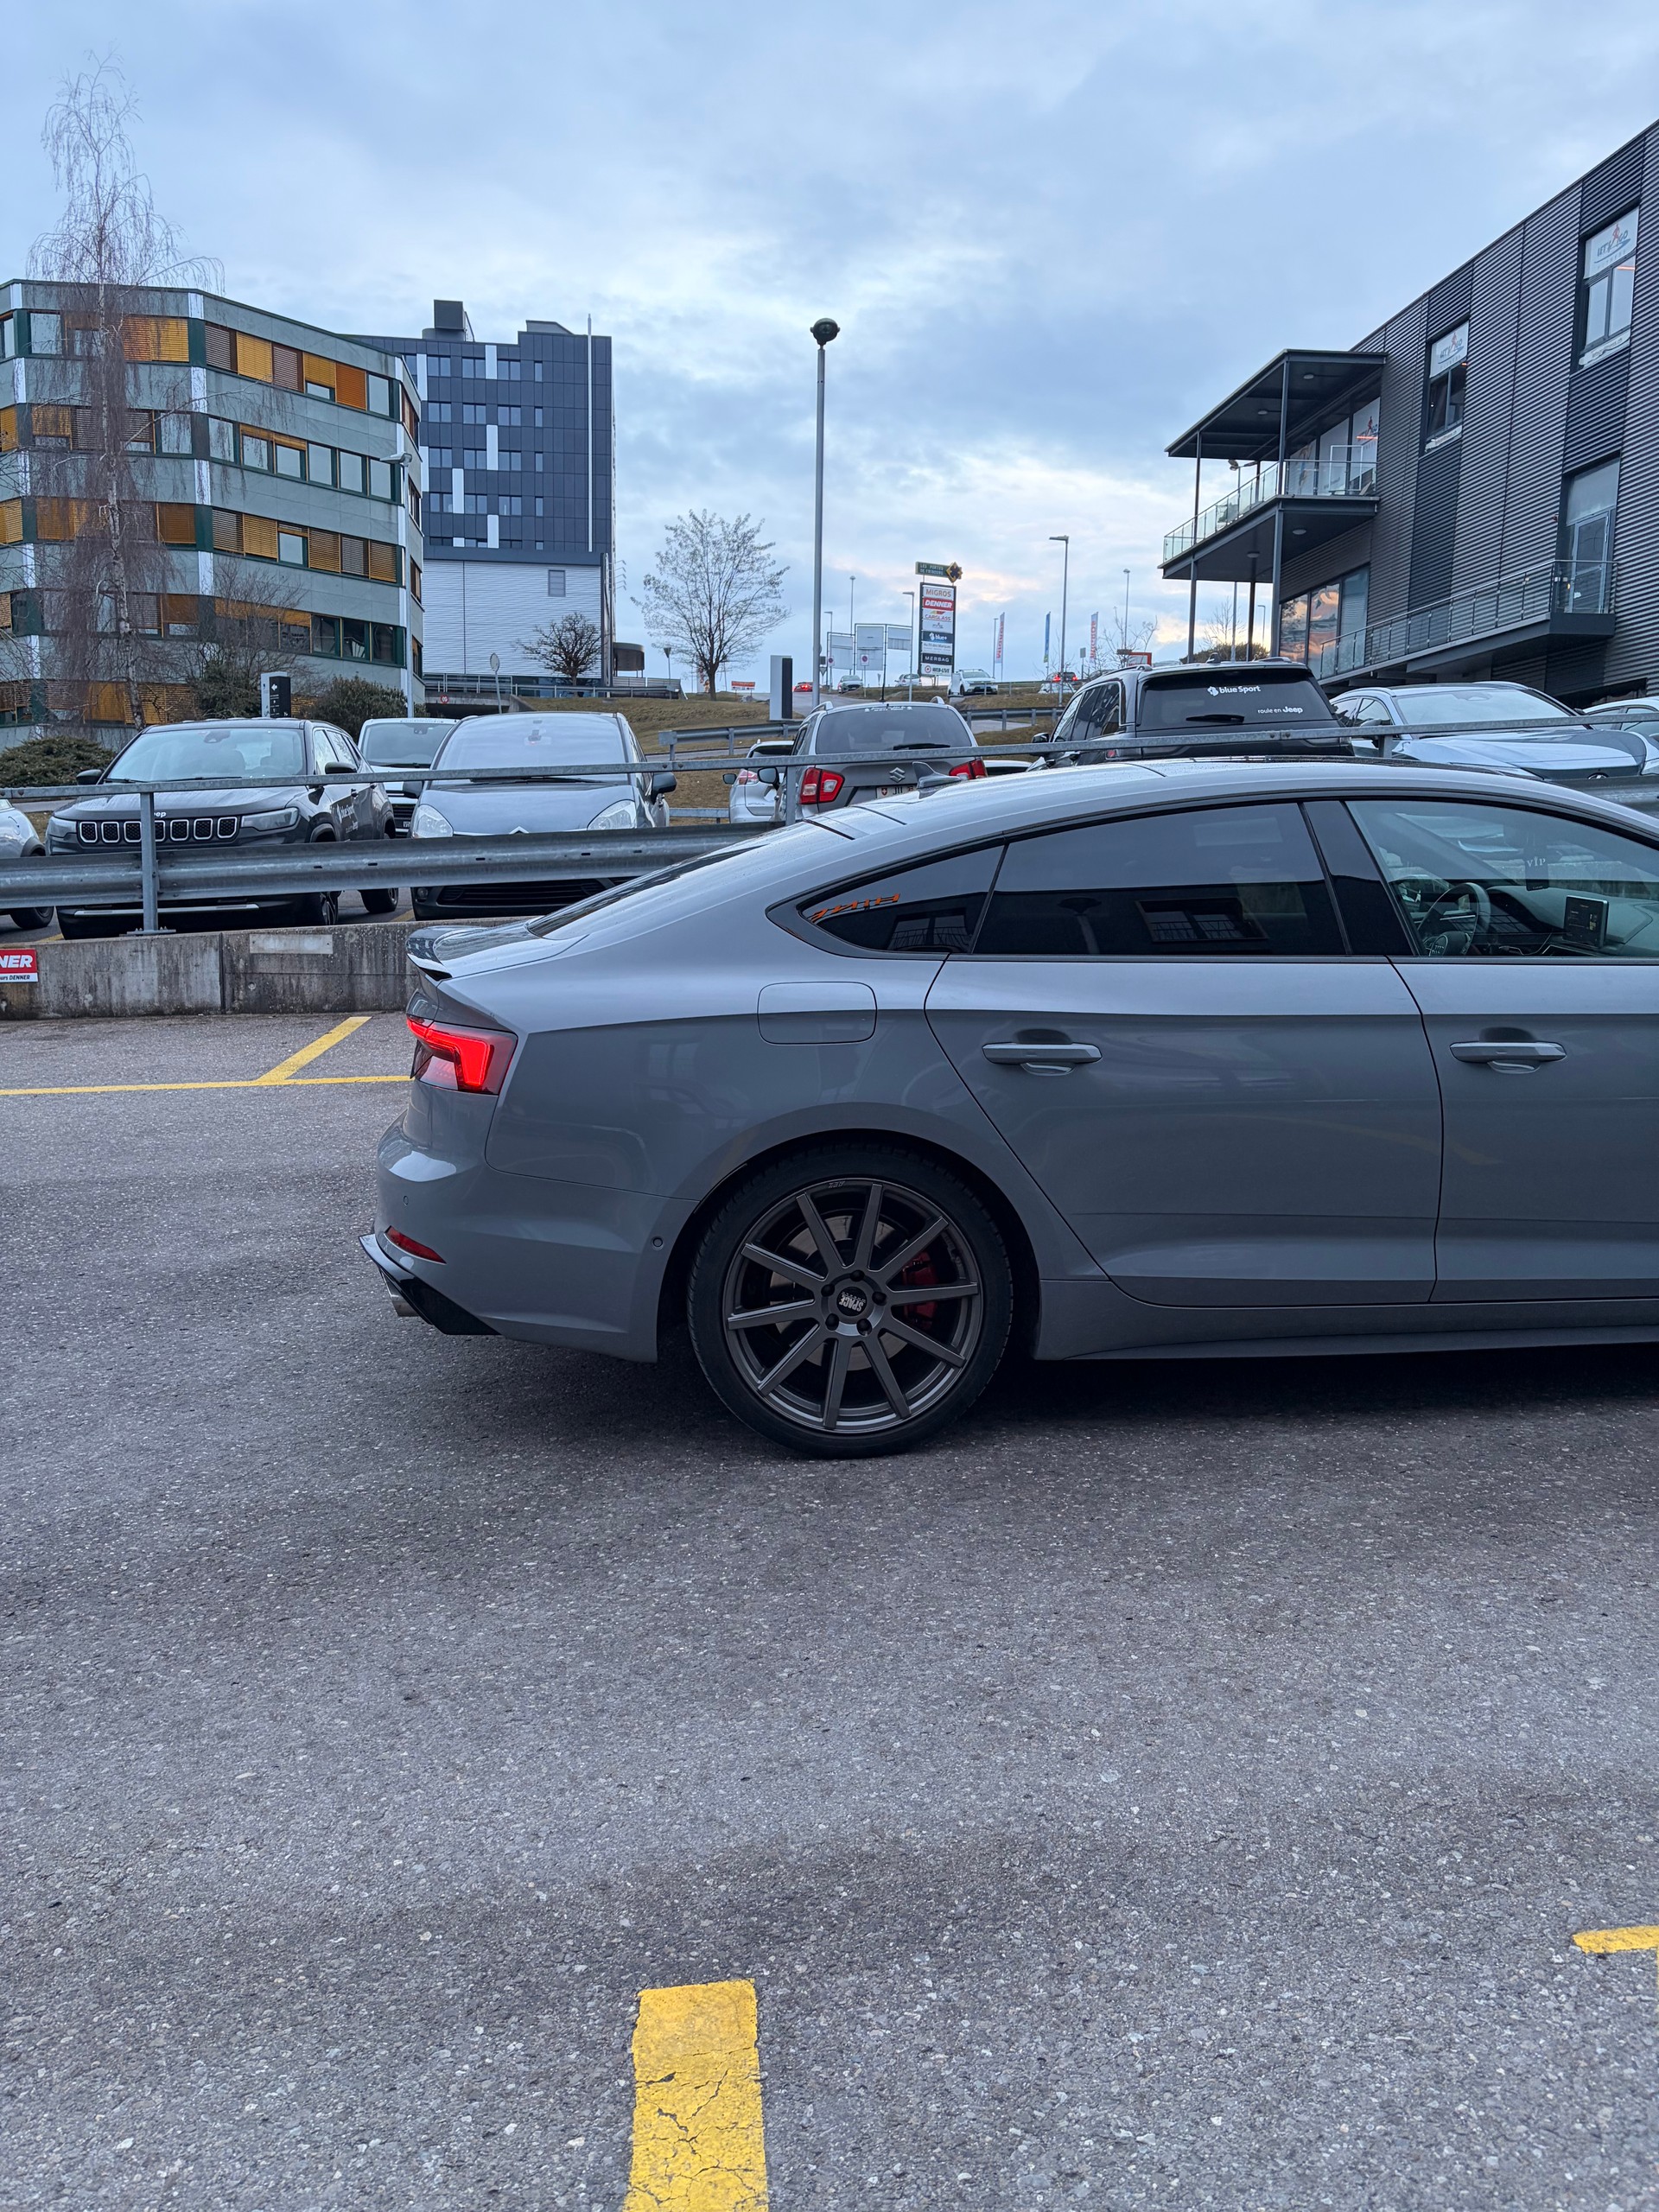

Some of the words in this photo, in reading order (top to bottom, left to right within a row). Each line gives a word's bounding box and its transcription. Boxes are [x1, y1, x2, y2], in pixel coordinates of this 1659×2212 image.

[925, 588, 951, 597] MIGROS
[925, 600, 952, 608] DENNER
[1238, 685, 1261, 694] Sport
[838, 1294, 864, 1313] SPACE
